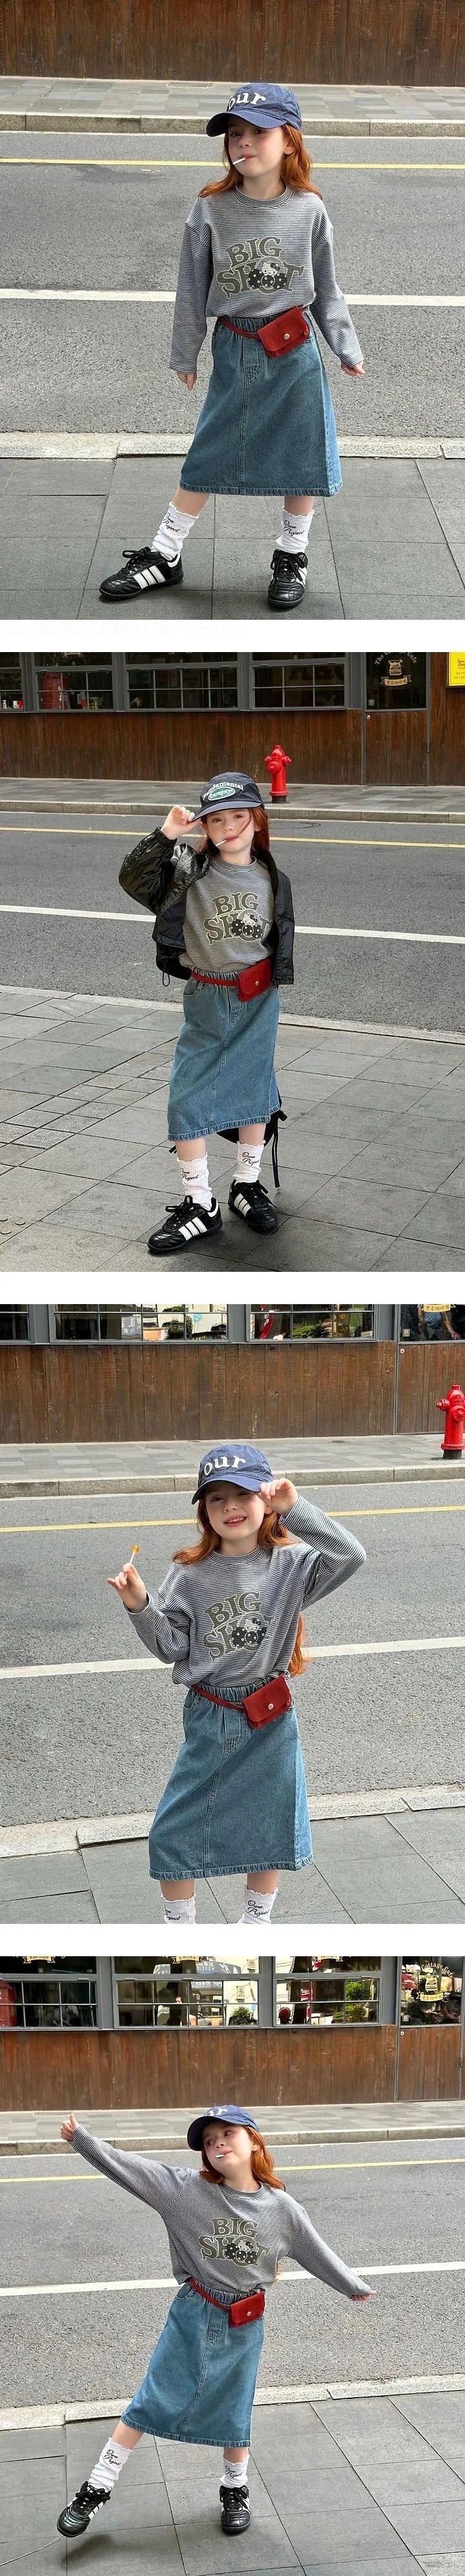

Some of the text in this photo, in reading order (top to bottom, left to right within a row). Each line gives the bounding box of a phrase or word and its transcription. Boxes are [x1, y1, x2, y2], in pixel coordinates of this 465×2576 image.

[228, 92, 266, 111] our
[225, 237, 283, 268] BIG
[211, 892, 260, 916] BIG
[203, 1455, 246, 1477] our
[205, 1592, 262, 1629] BIG
[212, 2217, 259, 2238] BIG
